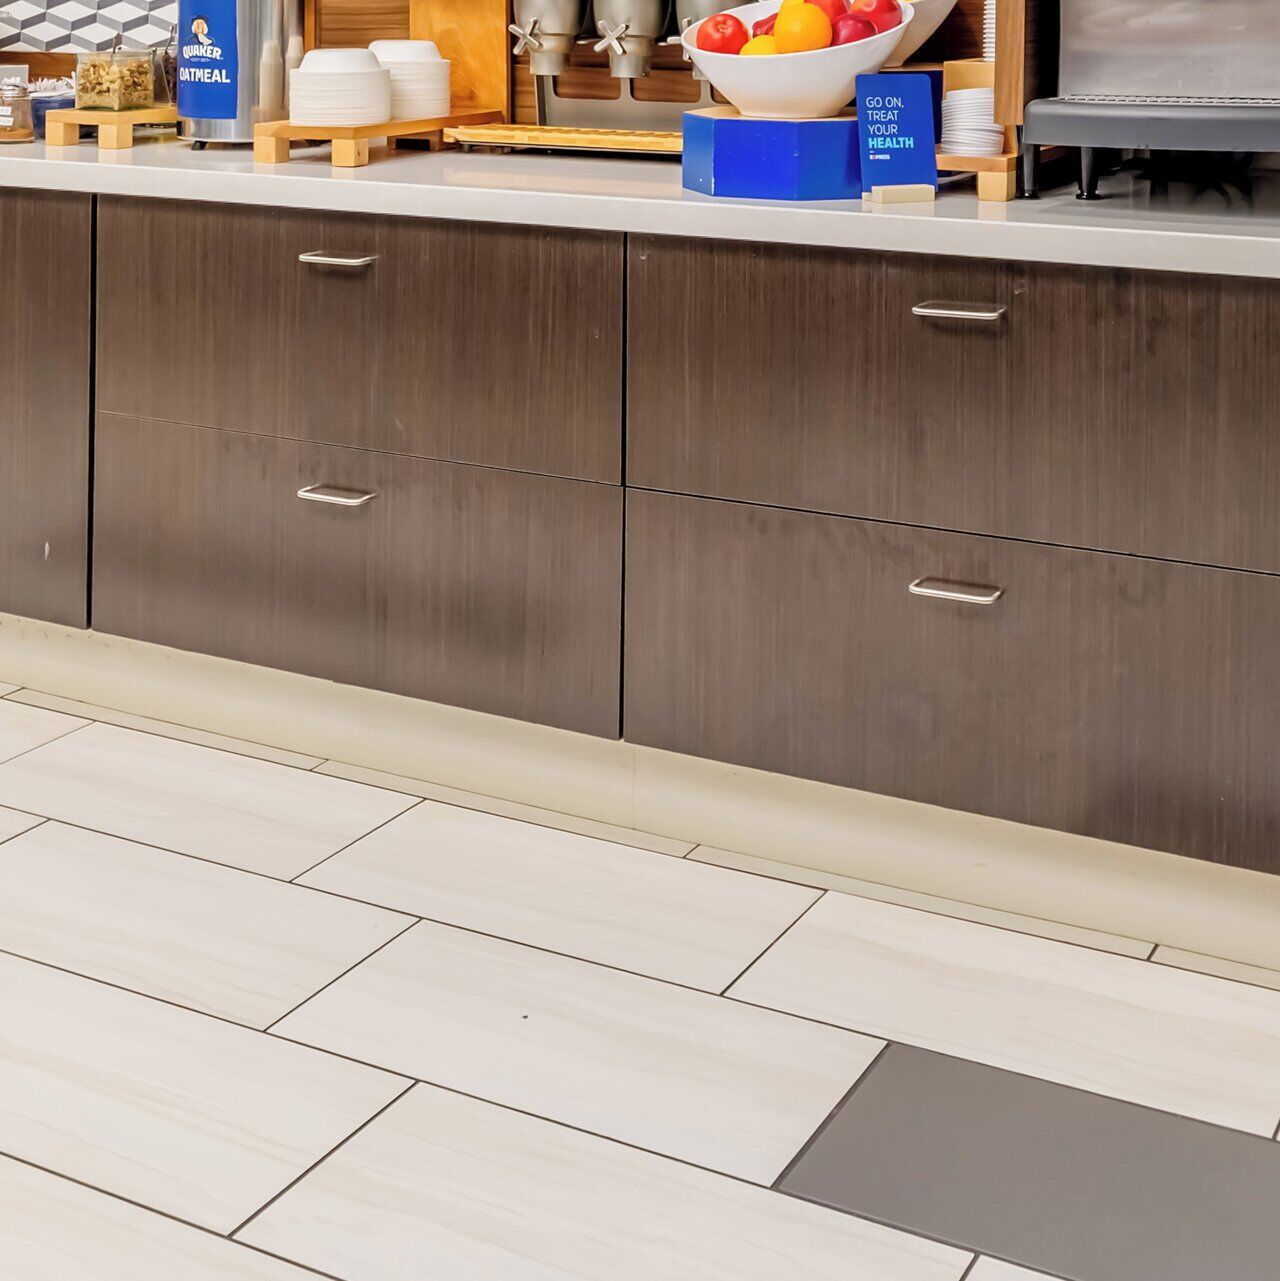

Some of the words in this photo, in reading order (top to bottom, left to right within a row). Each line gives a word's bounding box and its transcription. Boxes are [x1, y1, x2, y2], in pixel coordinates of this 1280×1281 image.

[183, 44, 222, 60] QUAKER
[180, 67, 231, 83] OATMEAL
[866, 96, 883, 108] GO
[885, 96, 904, 108] ON,
[866, 110, 899, 121] TREAT
[867, 124, 898, 135] YOUR
[868, 137, 914, 148] HEALTH
